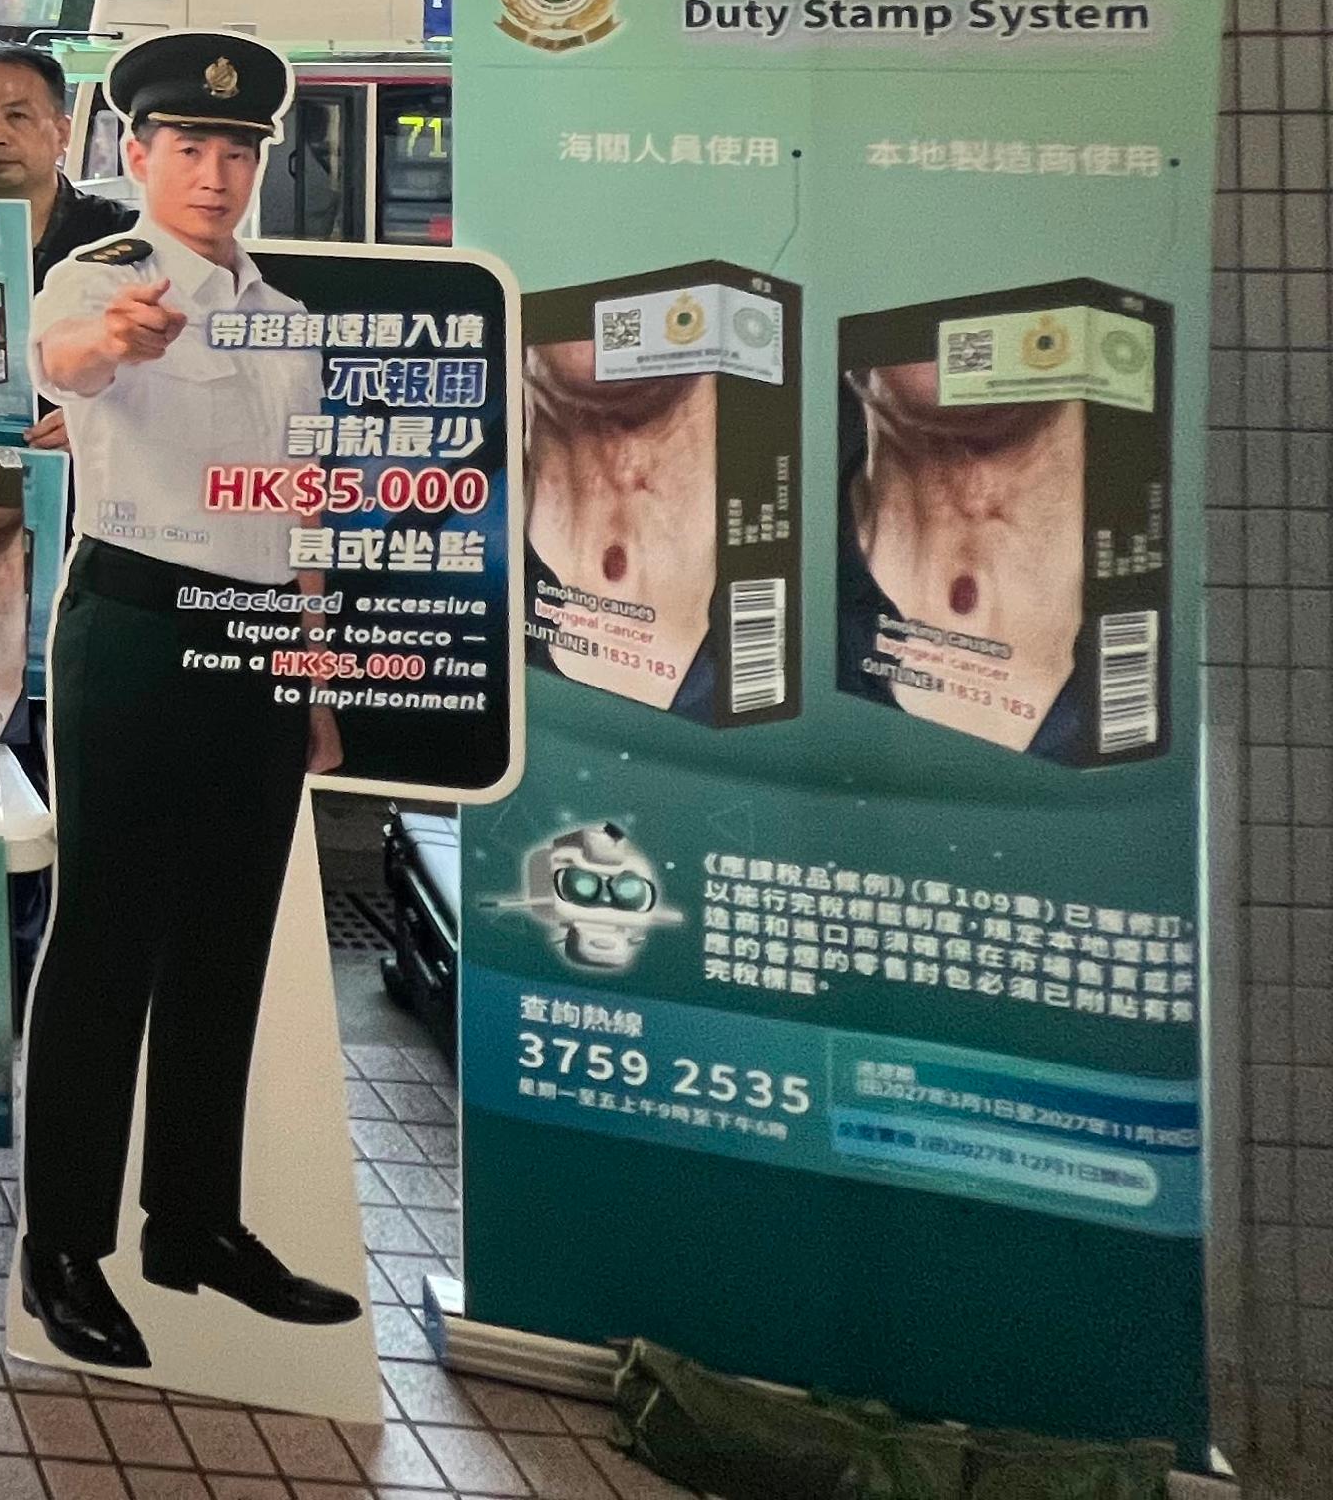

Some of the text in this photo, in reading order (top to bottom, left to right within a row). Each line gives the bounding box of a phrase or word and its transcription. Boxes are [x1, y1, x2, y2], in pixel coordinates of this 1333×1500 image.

[685, 0, 789, 35] Duty
[209, 313, 485, 350] 帶超額煙酒入境
[328, 357, 488, 406] 不報關
[287, 415, 485, 458] 罰款最少
[207, 463, 490, 516] HK$5,000
[288, 528, 486, 573] 甚或坐監
[176, 587, 488, 616] Undeclared excessive
[537, 580, 656, 621] Smoking causes
[226, 622, 299, 644] liquor
[309, 626, 337, 643] or
[344, 624, 453, 646] tobacco
[182, 648, 488, 681] from a HK$5,000 fine
[602, 644, 642, 669] 1833
[645, 657, 677, 680] 183
[274, 684, 486, 712] to imprisonment
[518, 1031, 811, 1115] 3759 2535
